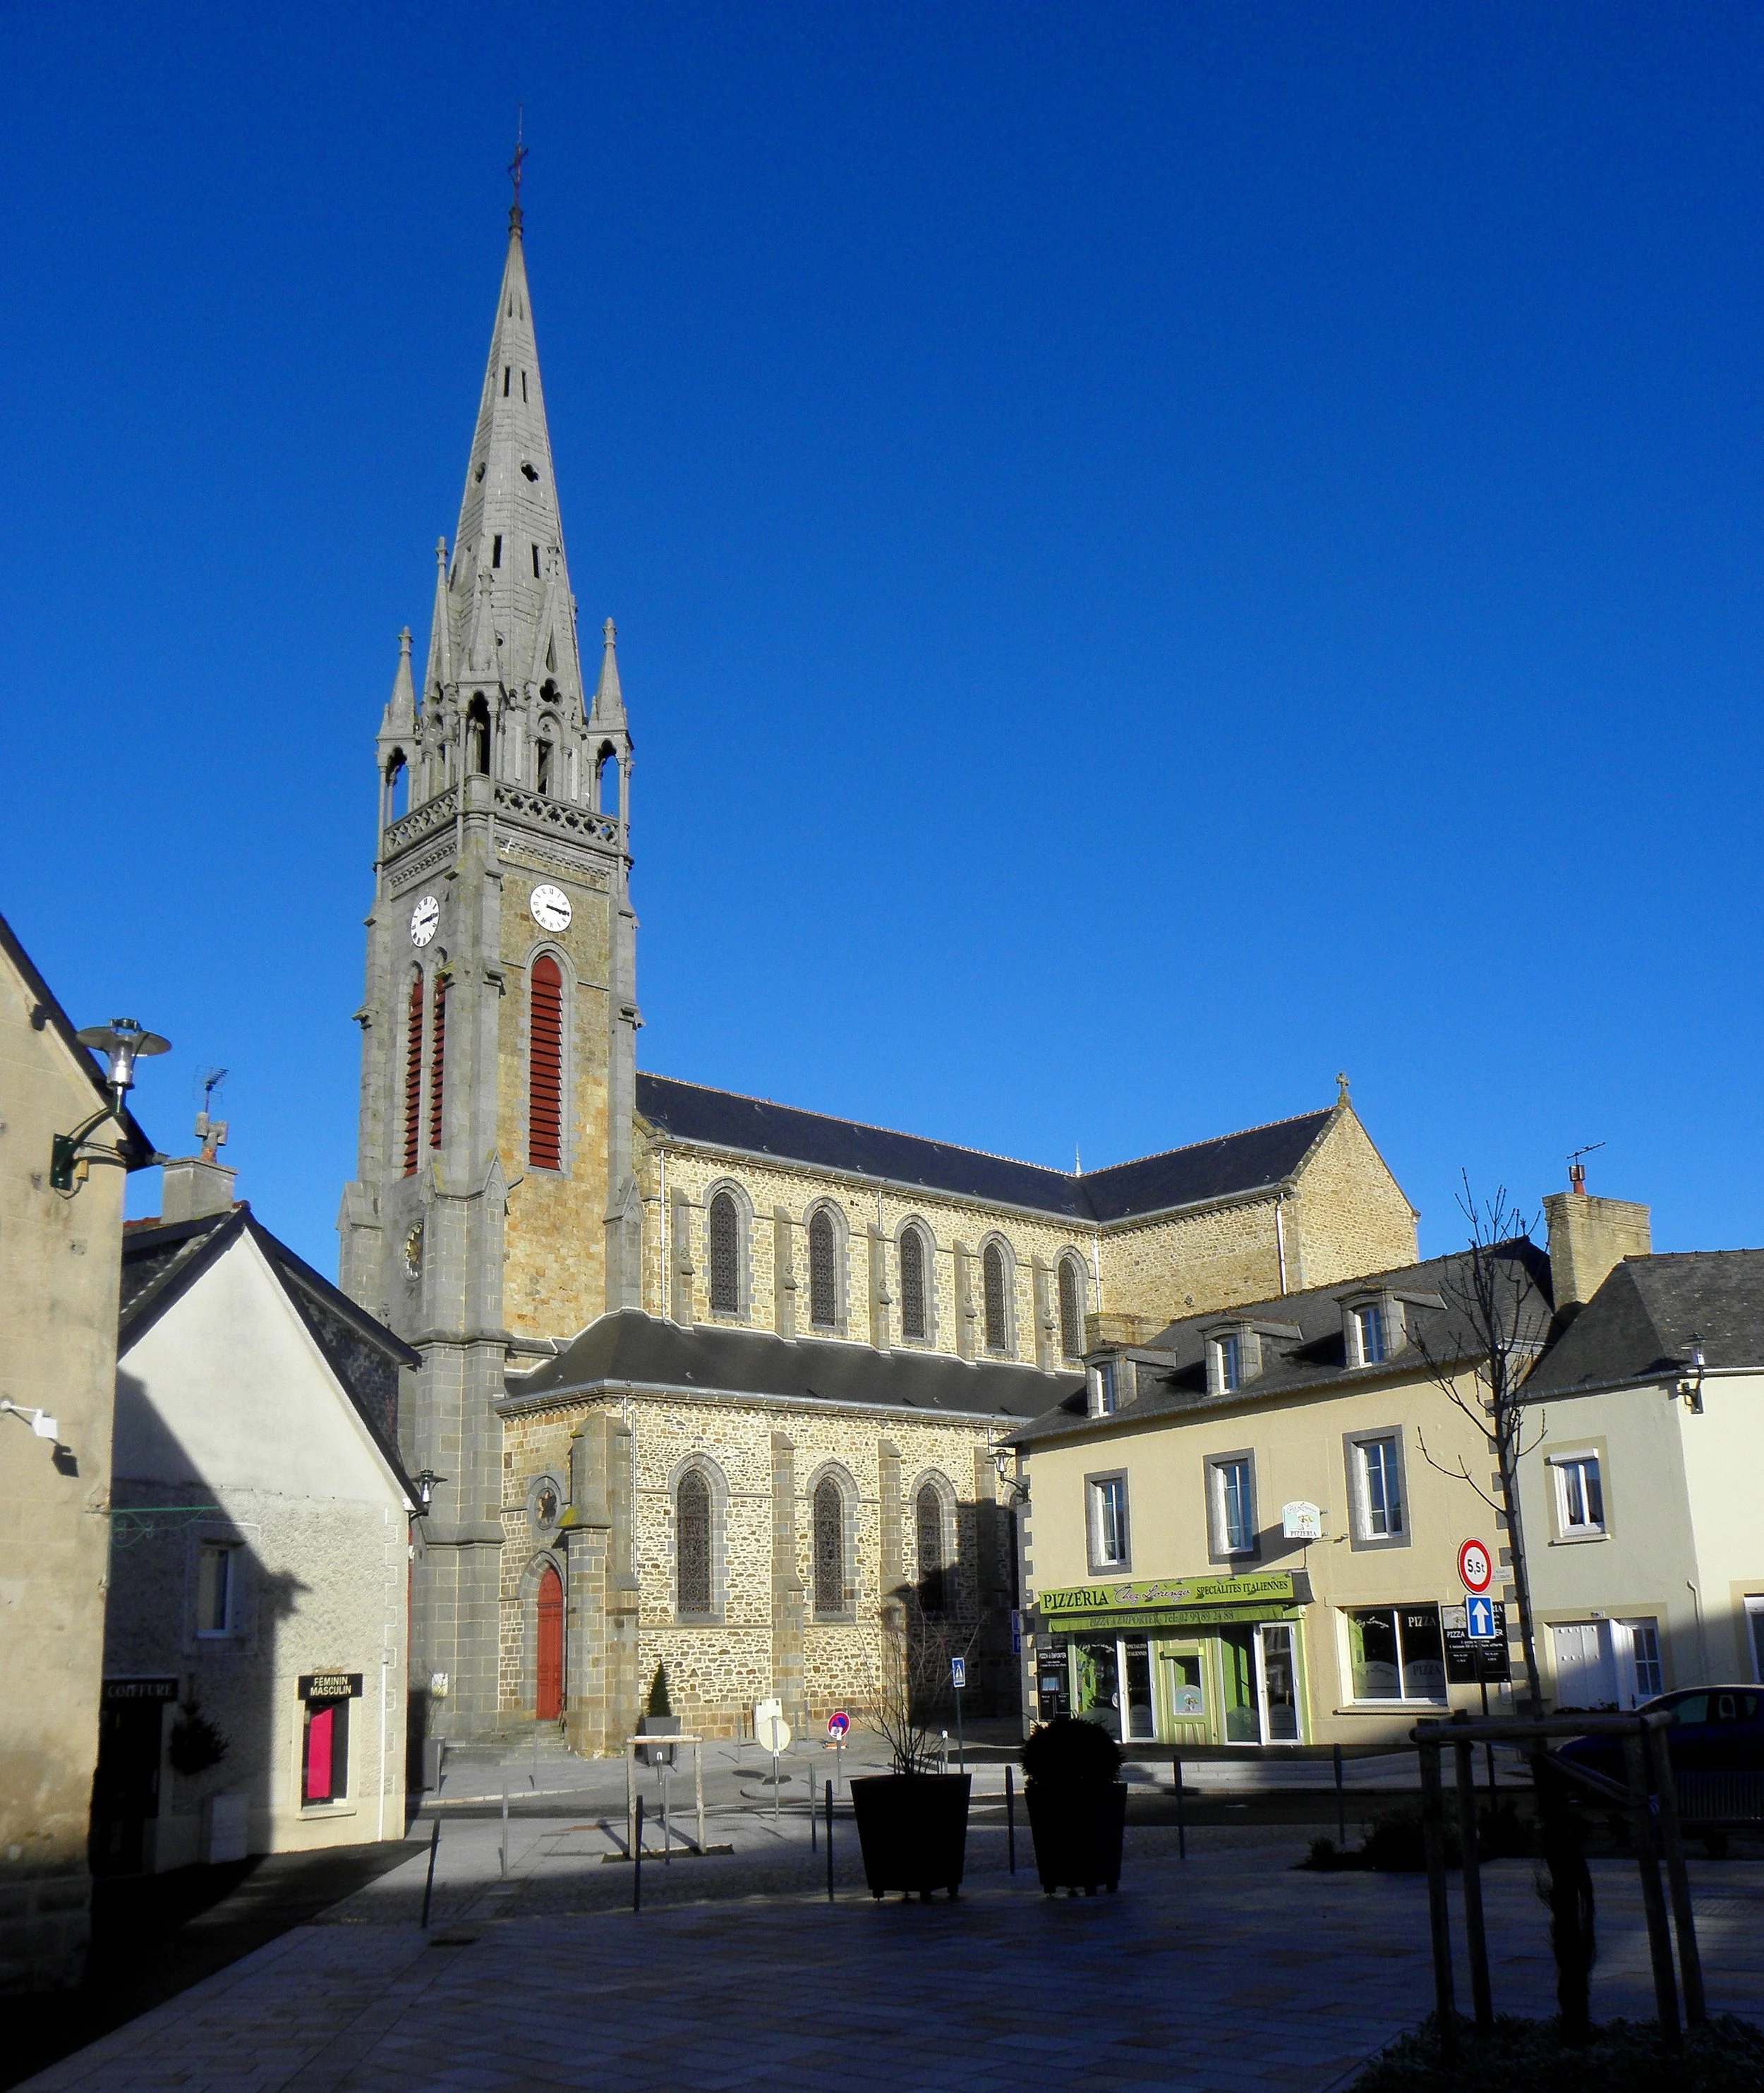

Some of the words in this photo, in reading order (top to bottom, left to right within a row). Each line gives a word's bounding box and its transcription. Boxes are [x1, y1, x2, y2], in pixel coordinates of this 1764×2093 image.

[1467, 1559, 1485, 1576] 5,5t
[1043, 1589, 1109, 1609] PIZZERIA
[1113, 1585, 1140, 1605] Chez
[1142, 1584, 1191, 1603] Lorenzo
[1196, 1584, 1242, 1596] SPECIALITES
[1243, 1580, 1288, 1593] ITALIENNES
[1407, 1615, 1437, 1627] PIZZA
[310, 1685, 352, 1696] MASCULIN
